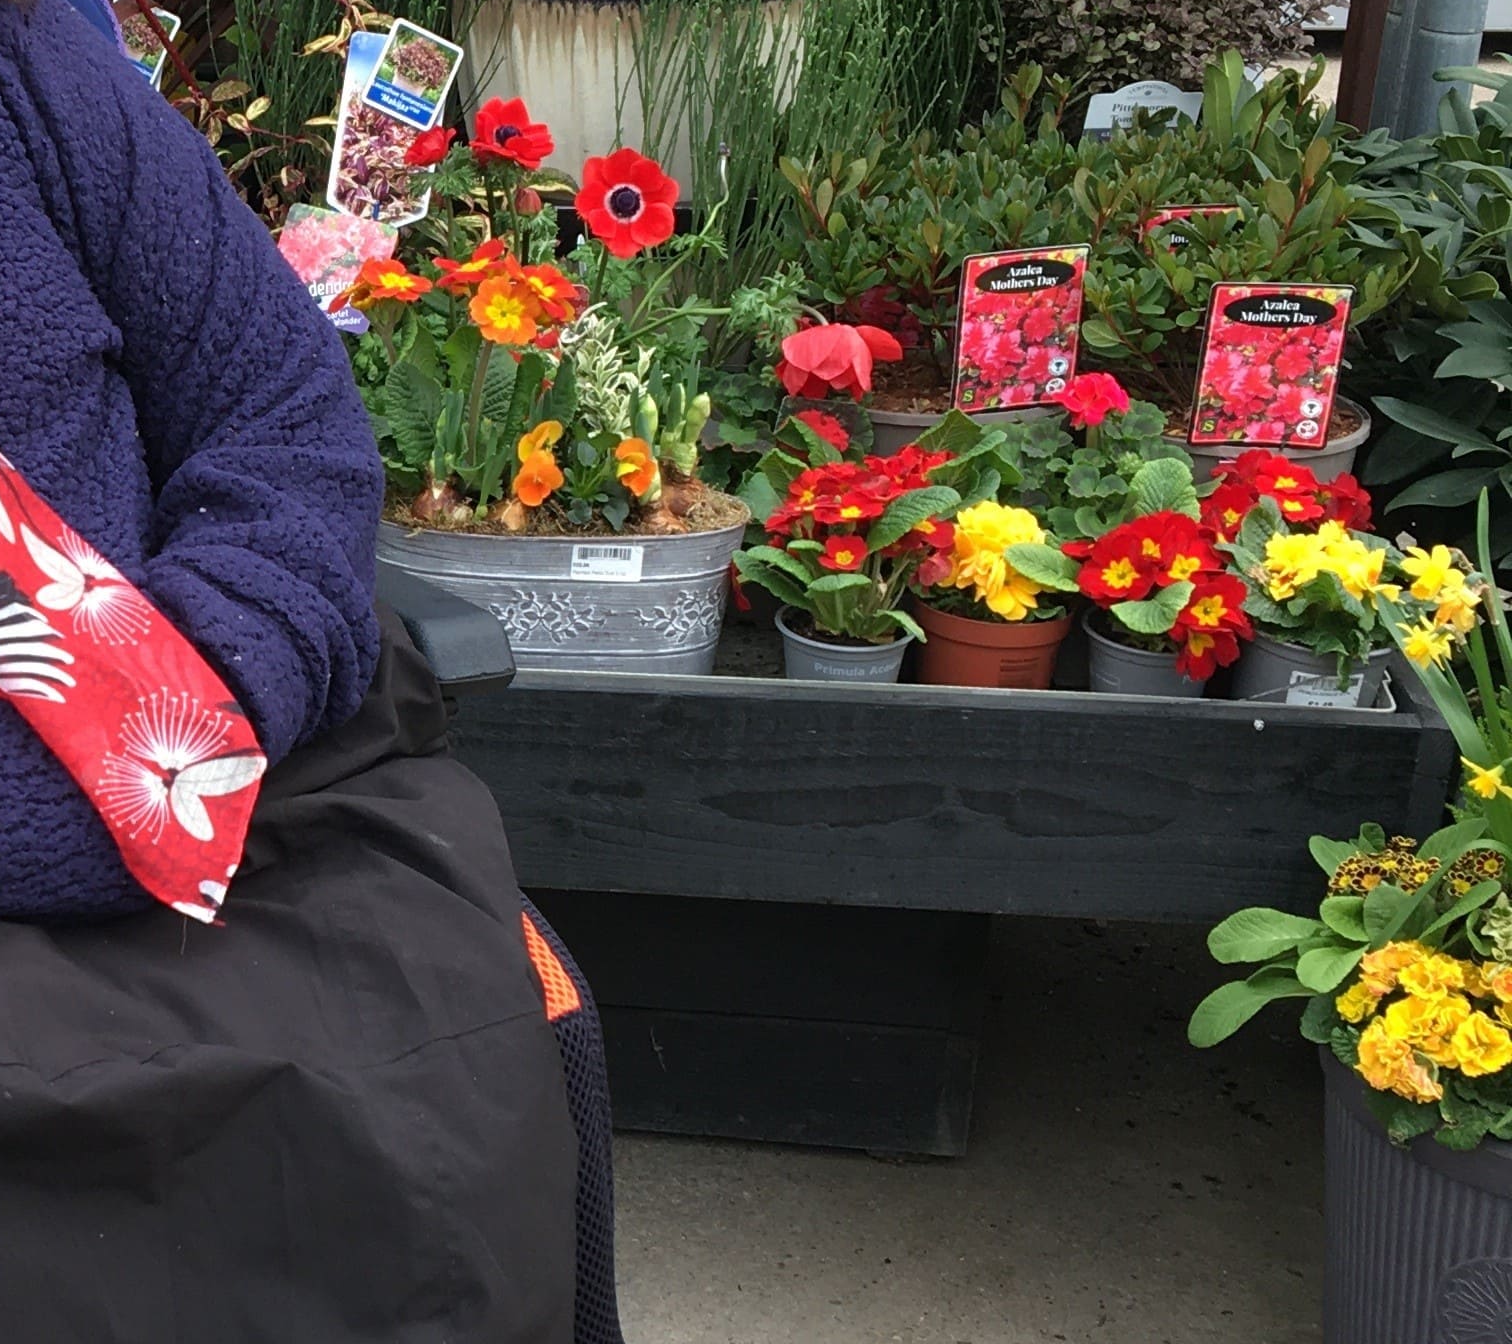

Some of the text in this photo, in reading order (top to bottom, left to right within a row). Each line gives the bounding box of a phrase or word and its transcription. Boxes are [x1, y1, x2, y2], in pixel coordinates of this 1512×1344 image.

[1007, 264, 1043, 277] Azalea
[990, 276, 1059, 291] Mothers Day
[1260, 299, 1301, 311] Azalea
[1240, 311, 1318, 325] Mothers Day
[814, 662, 865, 676] Primula
